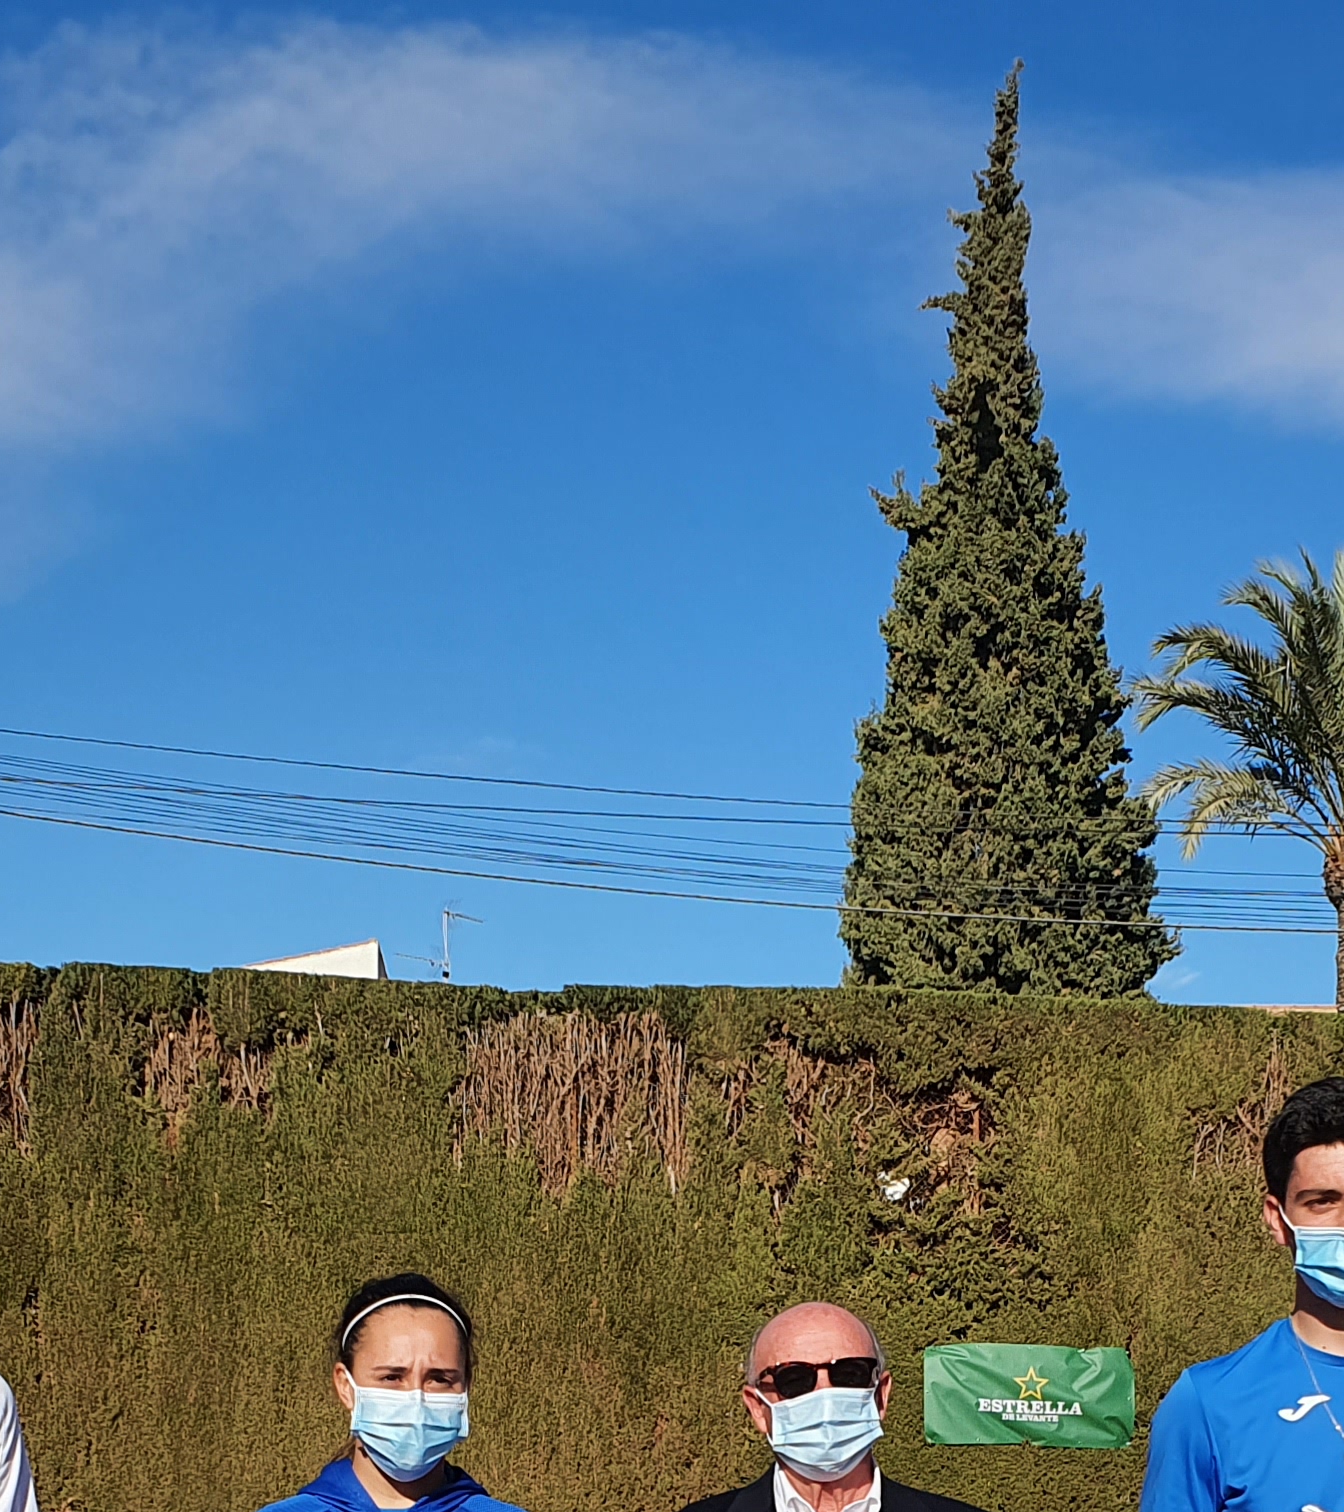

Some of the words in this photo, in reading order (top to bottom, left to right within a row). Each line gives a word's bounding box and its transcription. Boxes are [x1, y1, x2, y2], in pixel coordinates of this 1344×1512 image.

[978, 1398, 1083, 1415] ESTRELLA
[1002, 1413, 1015, 1421] DE
[1016, 1414, 1059, 1423] LEVANTE
